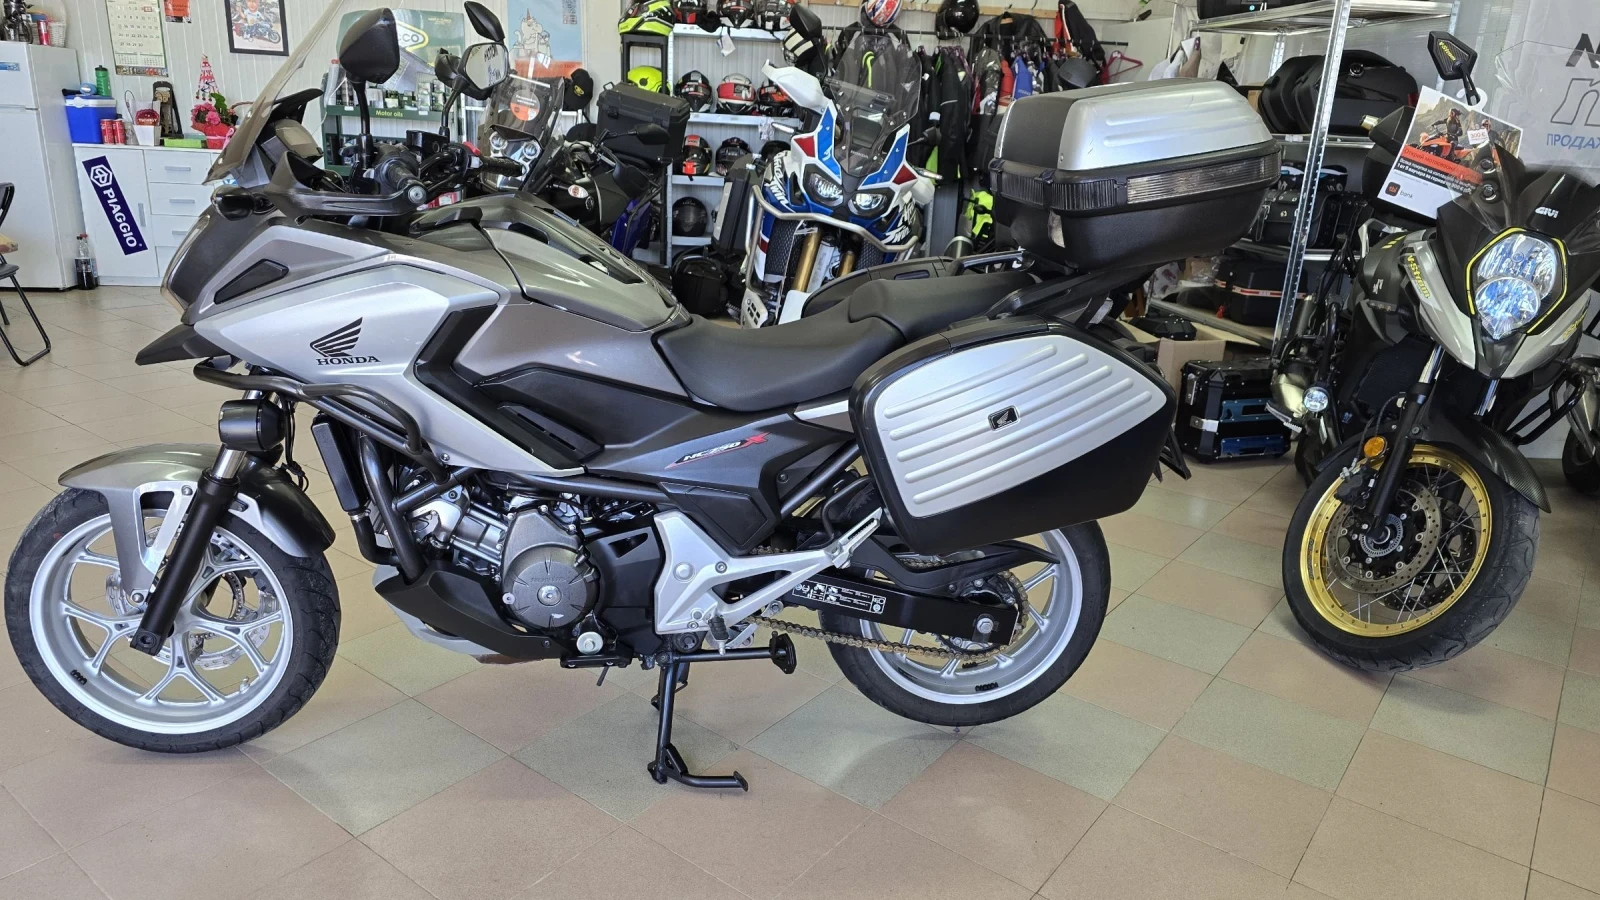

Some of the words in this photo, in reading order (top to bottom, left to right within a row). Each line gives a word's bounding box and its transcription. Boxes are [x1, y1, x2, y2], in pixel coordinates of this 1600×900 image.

[1403, 148, 1424, 160] Открий
[1399, 189, 1414, 198] bank
[103, 187, 137, 248] PIAGGIO
[1535, 206, 1559, 218] GIVI
[1407, 254, 1430, 299] V-Strom
[316, 355, 381, 365] HONDA
